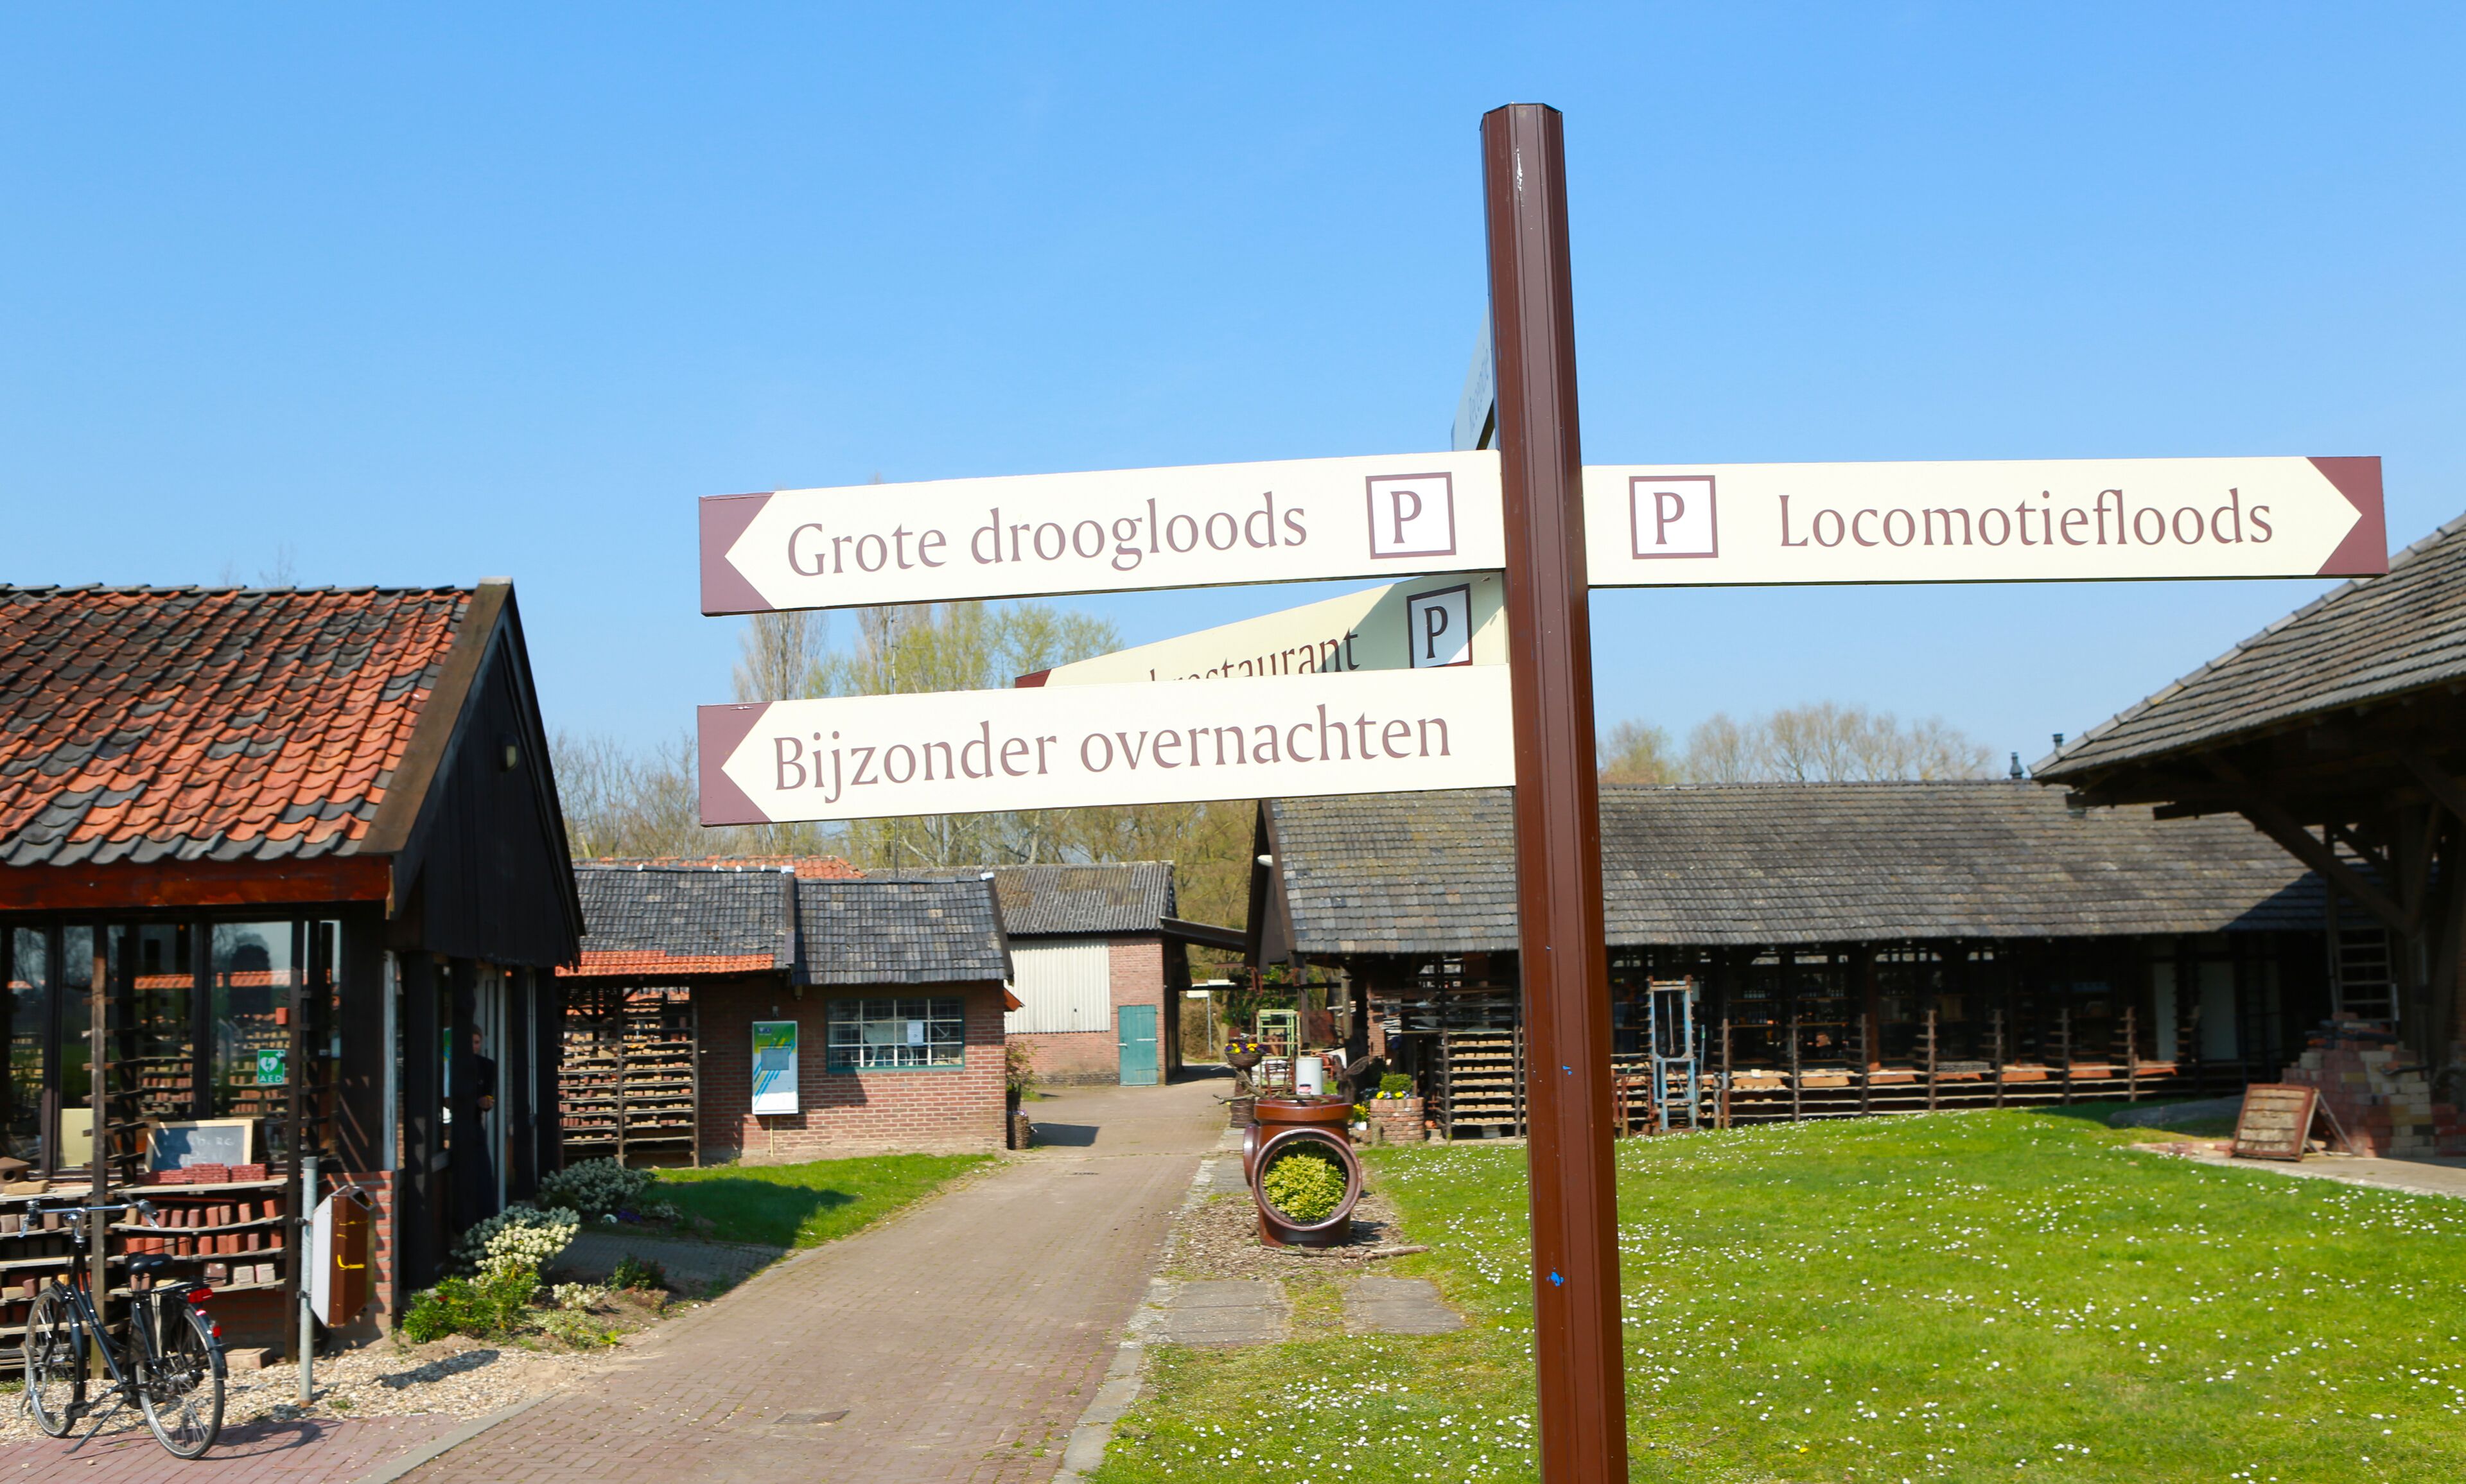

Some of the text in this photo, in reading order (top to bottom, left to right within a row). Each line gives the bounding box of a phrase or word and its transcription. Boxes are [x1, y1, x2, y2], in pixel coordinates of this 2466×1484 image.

[787, 490, 1422, 577] Grote droogloods P
[1653, 487, 2273, 548] P Locomotiefloods
[1424, 606, 1448, 659] P
[773, 703, 1451, 804] Bijzonder overnachten
[259, 1074, 283, 1083] AED
